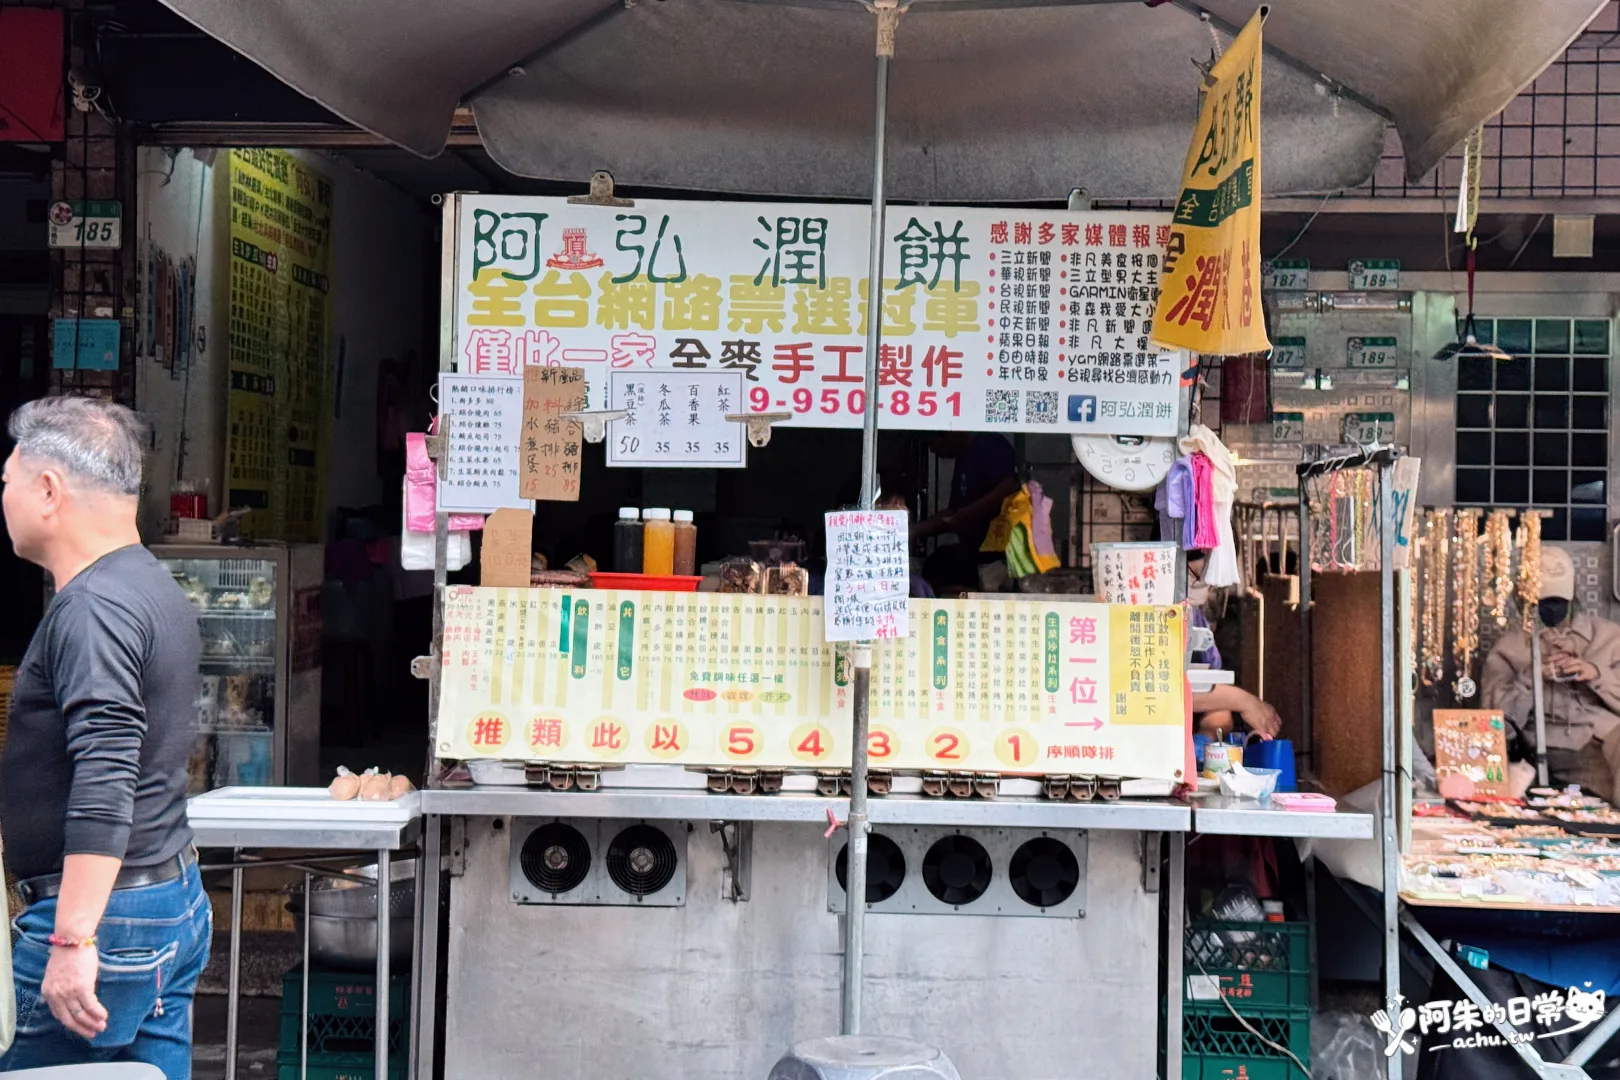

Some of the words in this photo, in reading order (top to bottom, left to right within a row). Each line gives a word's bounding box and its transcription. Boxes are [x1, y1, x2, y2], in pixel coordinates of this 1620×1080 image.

[74, 222, 113, 241] 185
[473, 208, 971, 292] 阿弘潤餅
[1000, 251, 1051, 265] 三立新聞
[1000, 267, 1051, 281] 華視新聞
[1272, 274, 1296, 287] 187
[1362, 274, 1387, 287] 189
[999, 284, 1050, 298] 台視新聞
[467, 270, 981, 338] 全台網路票選冠軍
[999, 300, 1050, 314] 民視新聞
[999, 317, 1049, 331] 中天新聞
[998, 334, 1049, 348] 蘋果日報
[998, 351, 1049, 364] 自由時報
[1276, 351, 1293, 364] 87
[1361, 351, 1385, 364] 189
[998, 366, 1048, 381] 年代印象
[1068, 368, 1172, 385] 台視尋找台灣感動力
[624, 383, 637, 426] 黑豆茶
[658, 383, 671, 426] 冬瓜茶
[688, 384, 701, 426] 百香果
[717, 384, 731, 412] 紅茶
[1101, 400, 1172, 420] 阿弘潤餅
[1274, 425, 1291, 439] 87
[525, 417, 540, 474] 水煮蛋
[620, 435, 640, 454] 50
[655, 442, 670, 453] 35
[685, 442, 700, 453] 35
[714, 442, 729, 454] 35
[525, 478, 539, 492] 15
[1069, 616, 1097, 704] 第一位
[1129, 611, 1142, 693] 離開後恕不負責
[1144, 611, 1156, 715] 請讓工作人員看一下
[690, 672, 784, 684] 免費調味任選一樣
[1115, 692, 1127, 715] 謝謝
[474, 717, 503, 746] 推
[532, 718, 562, 747] 類
[592, 721, 622, 749] 此
[652, 724, 681, 751] 以
[728, 727, 755, 755] 5
[797, 728, 825, 757] 4
[867, 730, 891, 758] 3
[934, 733, 960, 759] 2
[1007, 735, 1021, 762] 1
